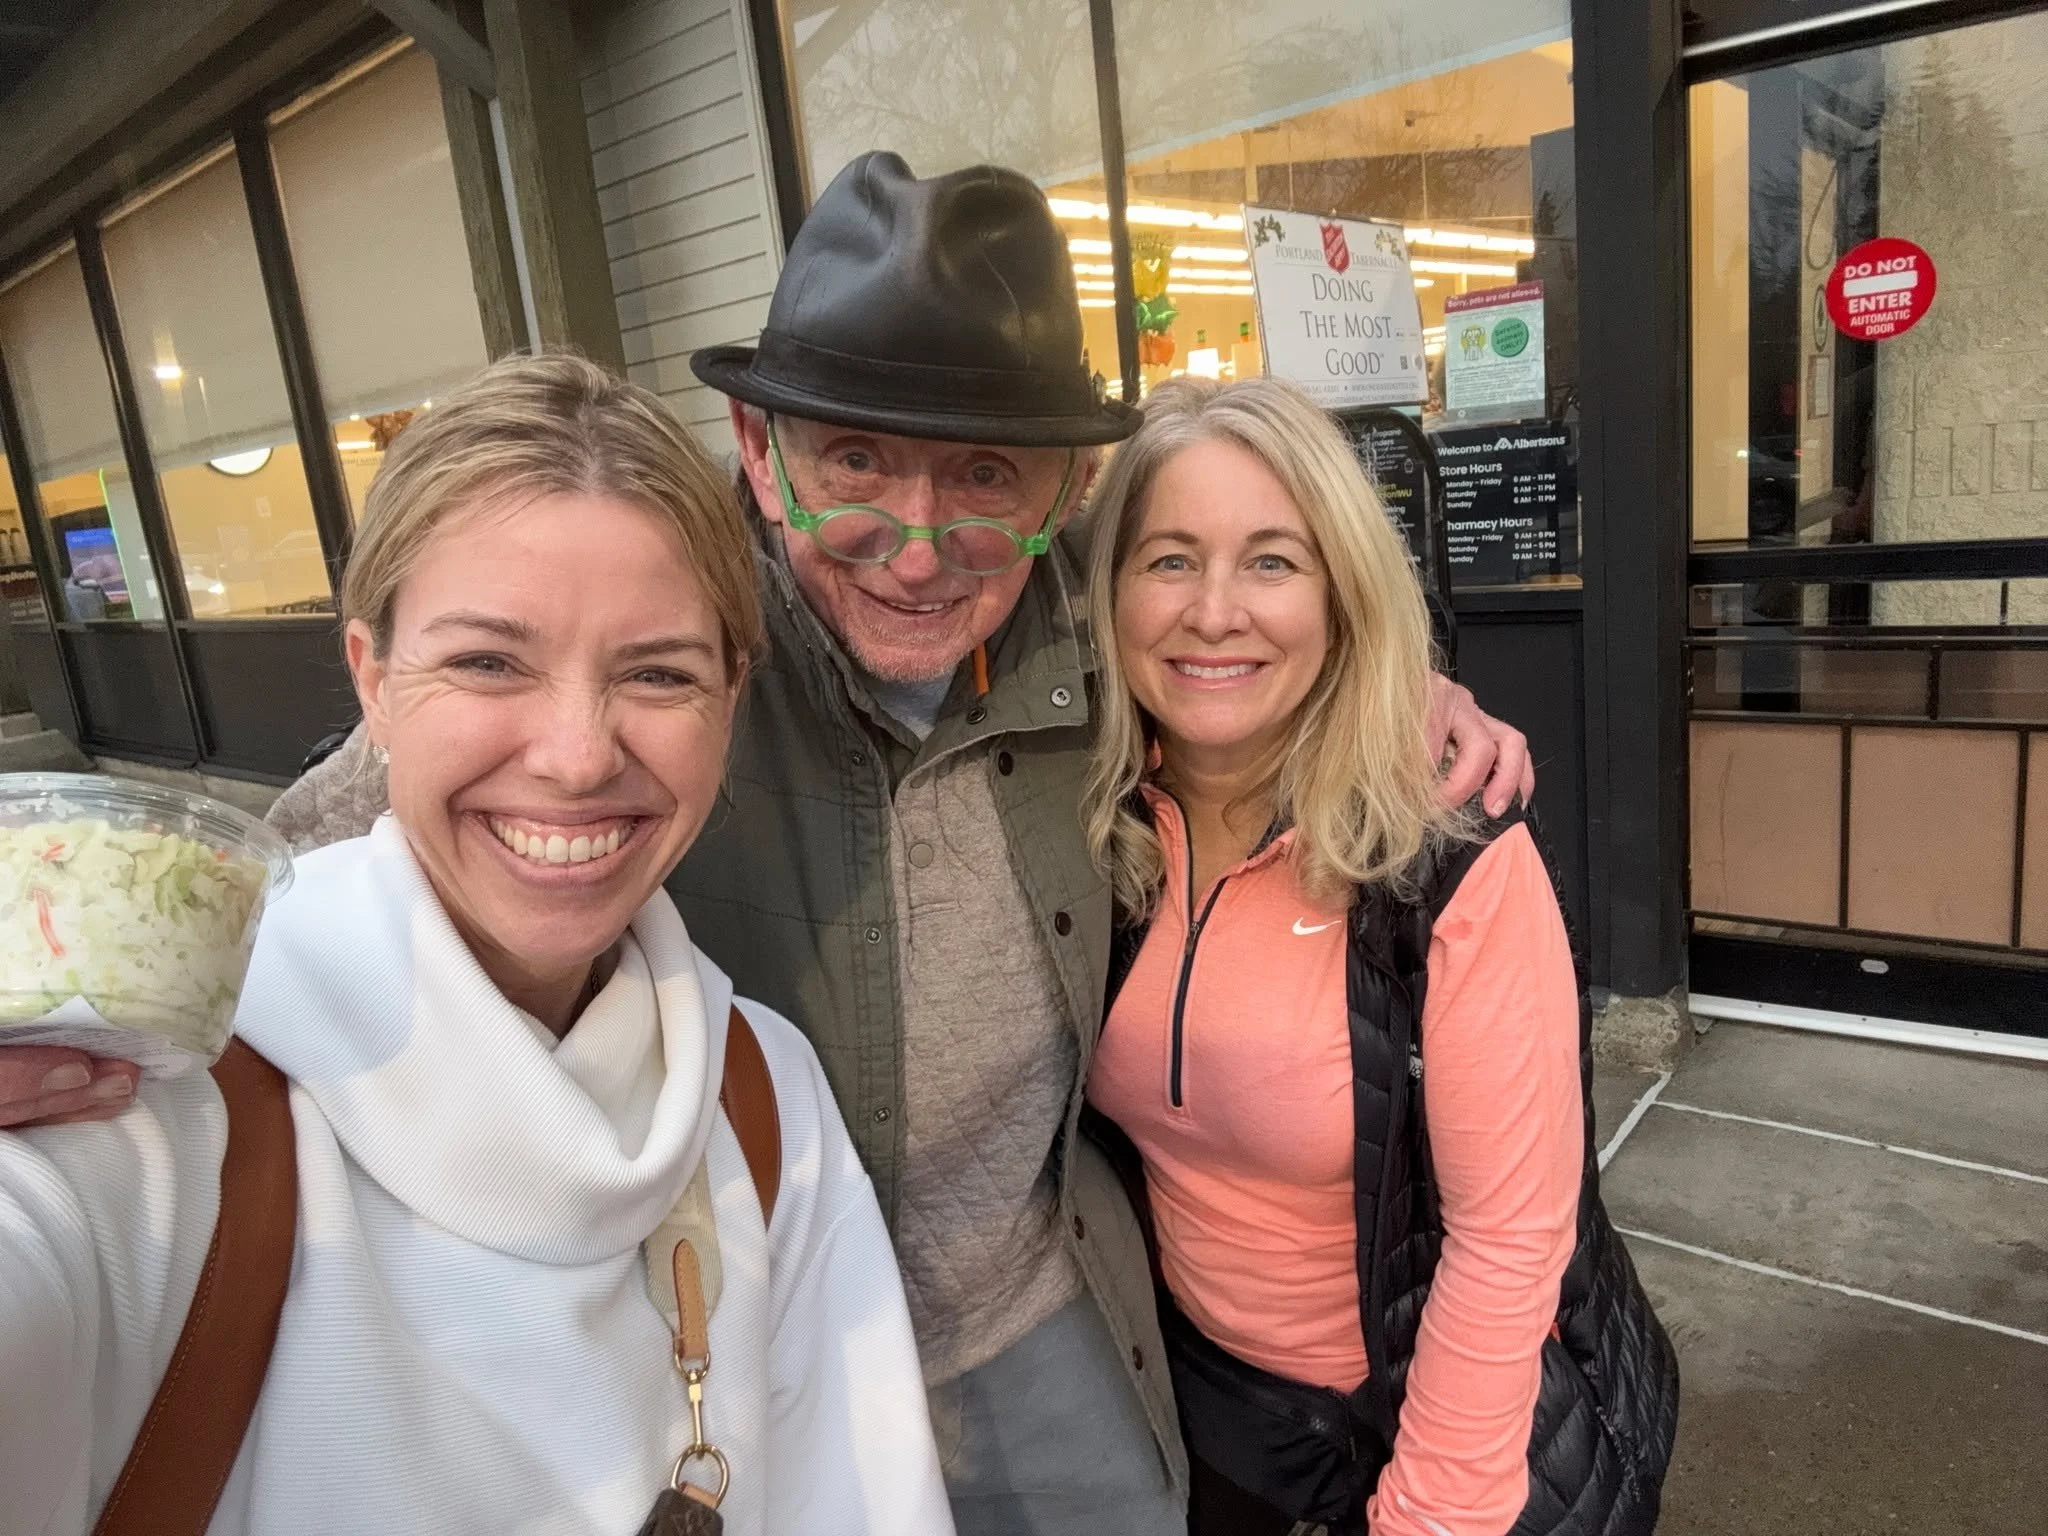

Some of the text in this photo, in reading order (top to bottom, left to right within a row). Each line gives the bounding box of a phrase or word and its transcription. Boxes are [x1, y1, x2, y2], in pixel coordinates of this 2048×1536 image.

[1844, 255, 1917, 278] DO NOT
[1311, 273, 1374, 302] DOING
[1498, 292, 1510, 300] not
[1848, 291, 1912, 314] ENTER
[1850, 309, 1911, 327] AUTOMATIC
[1300, 310, 1339, 339] THE
[1344, 311, 1392, 339] MOST
[1865, 323, 1895, 336] DOOR
[1437, 436, 1566, 456] Welcome to Albertsons
[1440, 463, 1503, 477] Store Hours
[1544, 473, 1556, 481] PM
[1446, 479, 1473, 488] Monday
[1480, 477, 1502, 486] Friday
[1520, 485, 1532, 493] AM
[1446, 490, 1477, 499] Saturday
[1520, 496, 1532, 504] AM
[1544, 494, 1556, 502] PM
[1446, 501, 1472, 509] Sunday
[1447, 518, 1533, 532] harmacy Hours
[1448, 536, 1475, 544] Monday
[1482, 533, 1504, 542] Friday
[1520, 531, 1532, 539] AM
[1448, 545, 1479, 553] Saturday
[1544, 541, 1556, 549] PM
[1448, 555, 1474, 564] Sunday
[1520, 552, 1532, 560] AM
[1544, 551, 1556, 559] PM
